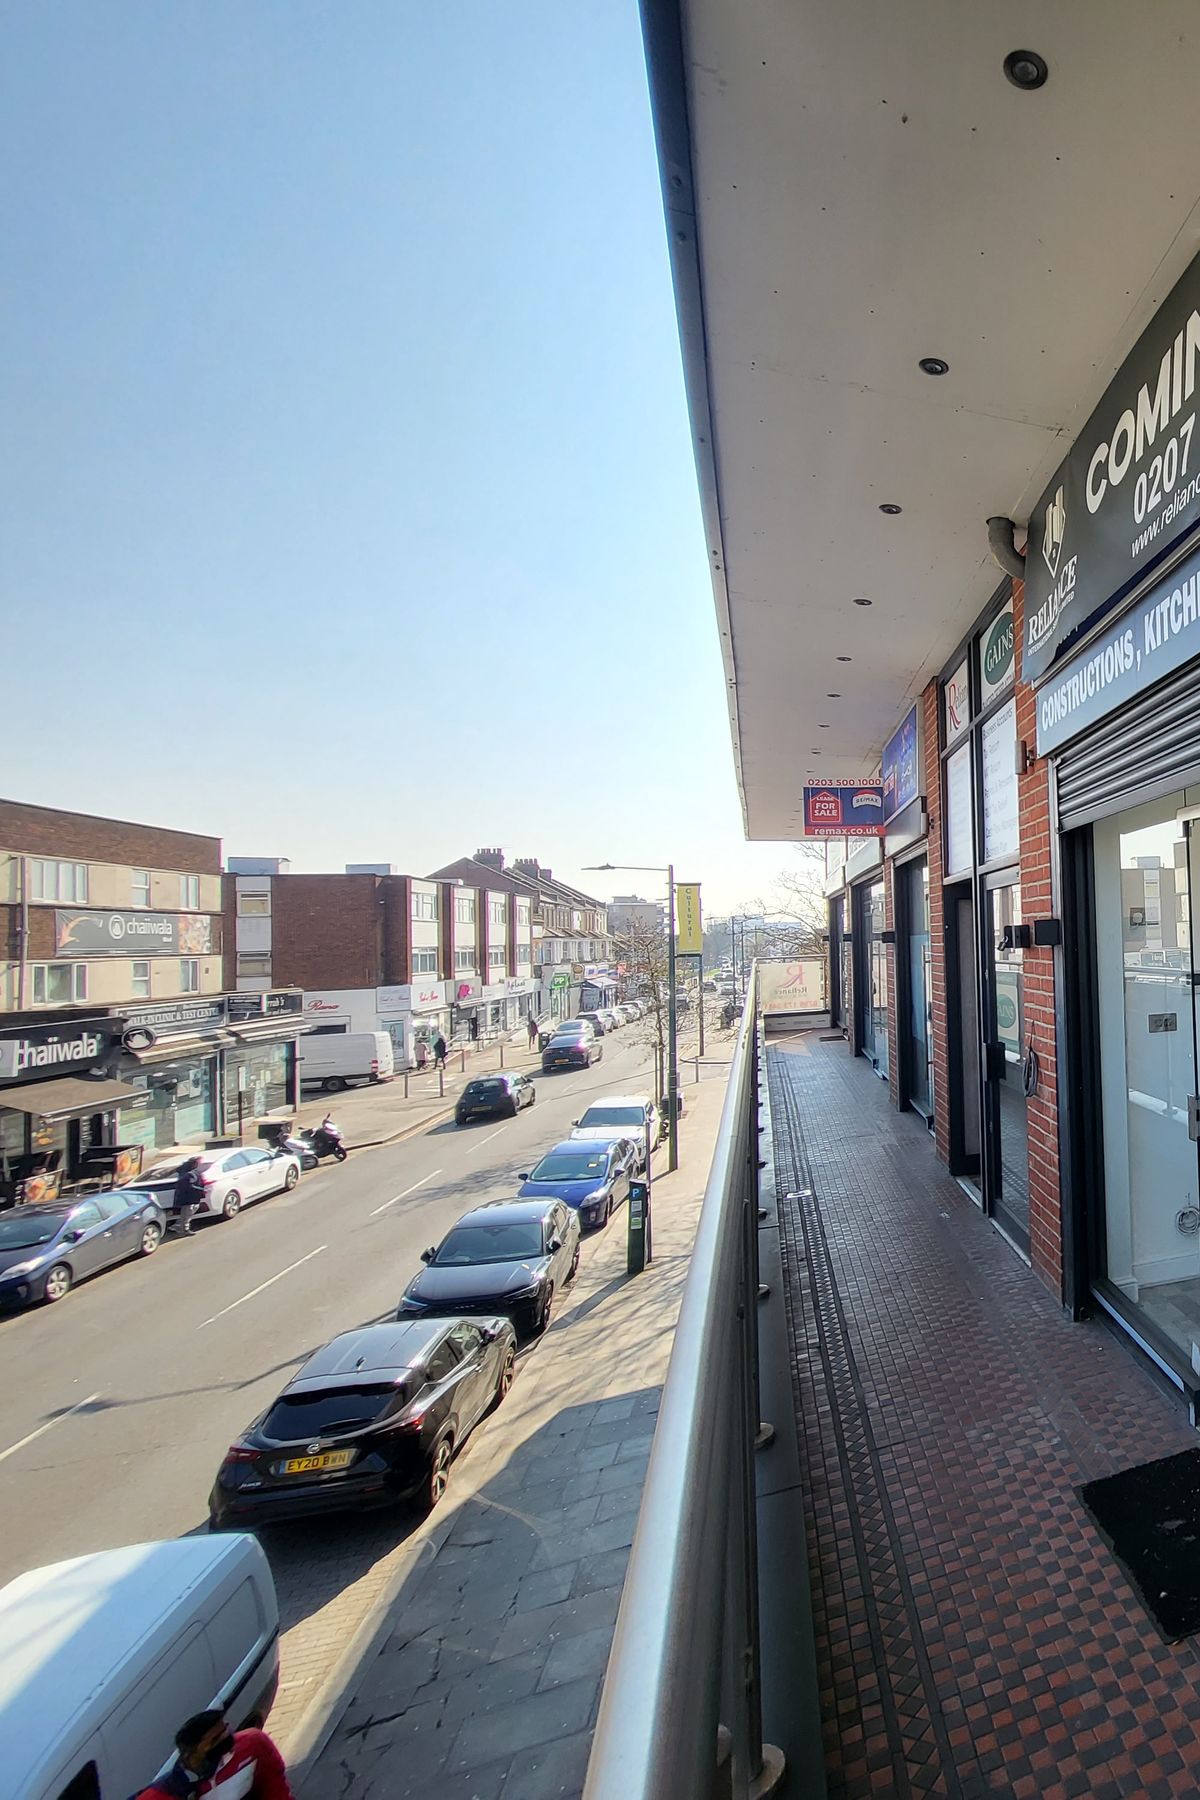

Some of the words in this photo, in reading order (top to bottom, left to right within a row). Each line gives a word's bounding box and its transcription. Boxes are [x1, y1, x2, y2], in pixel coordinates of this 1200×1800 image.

[1133, 412, 1196, 524] 0207
[986, 622, 1014, 673] GAINS
[808, 778, 833, 786] 0203
[836, 778, 855, 786] 500
[858, 778, 882, 786] 1000
[815, 802, 836, 810] FOR
[814, 809, 838, 817] SALE
[814, 826, 879, 835] remax.co.uk
[632, 1188, 640, 1198] P
